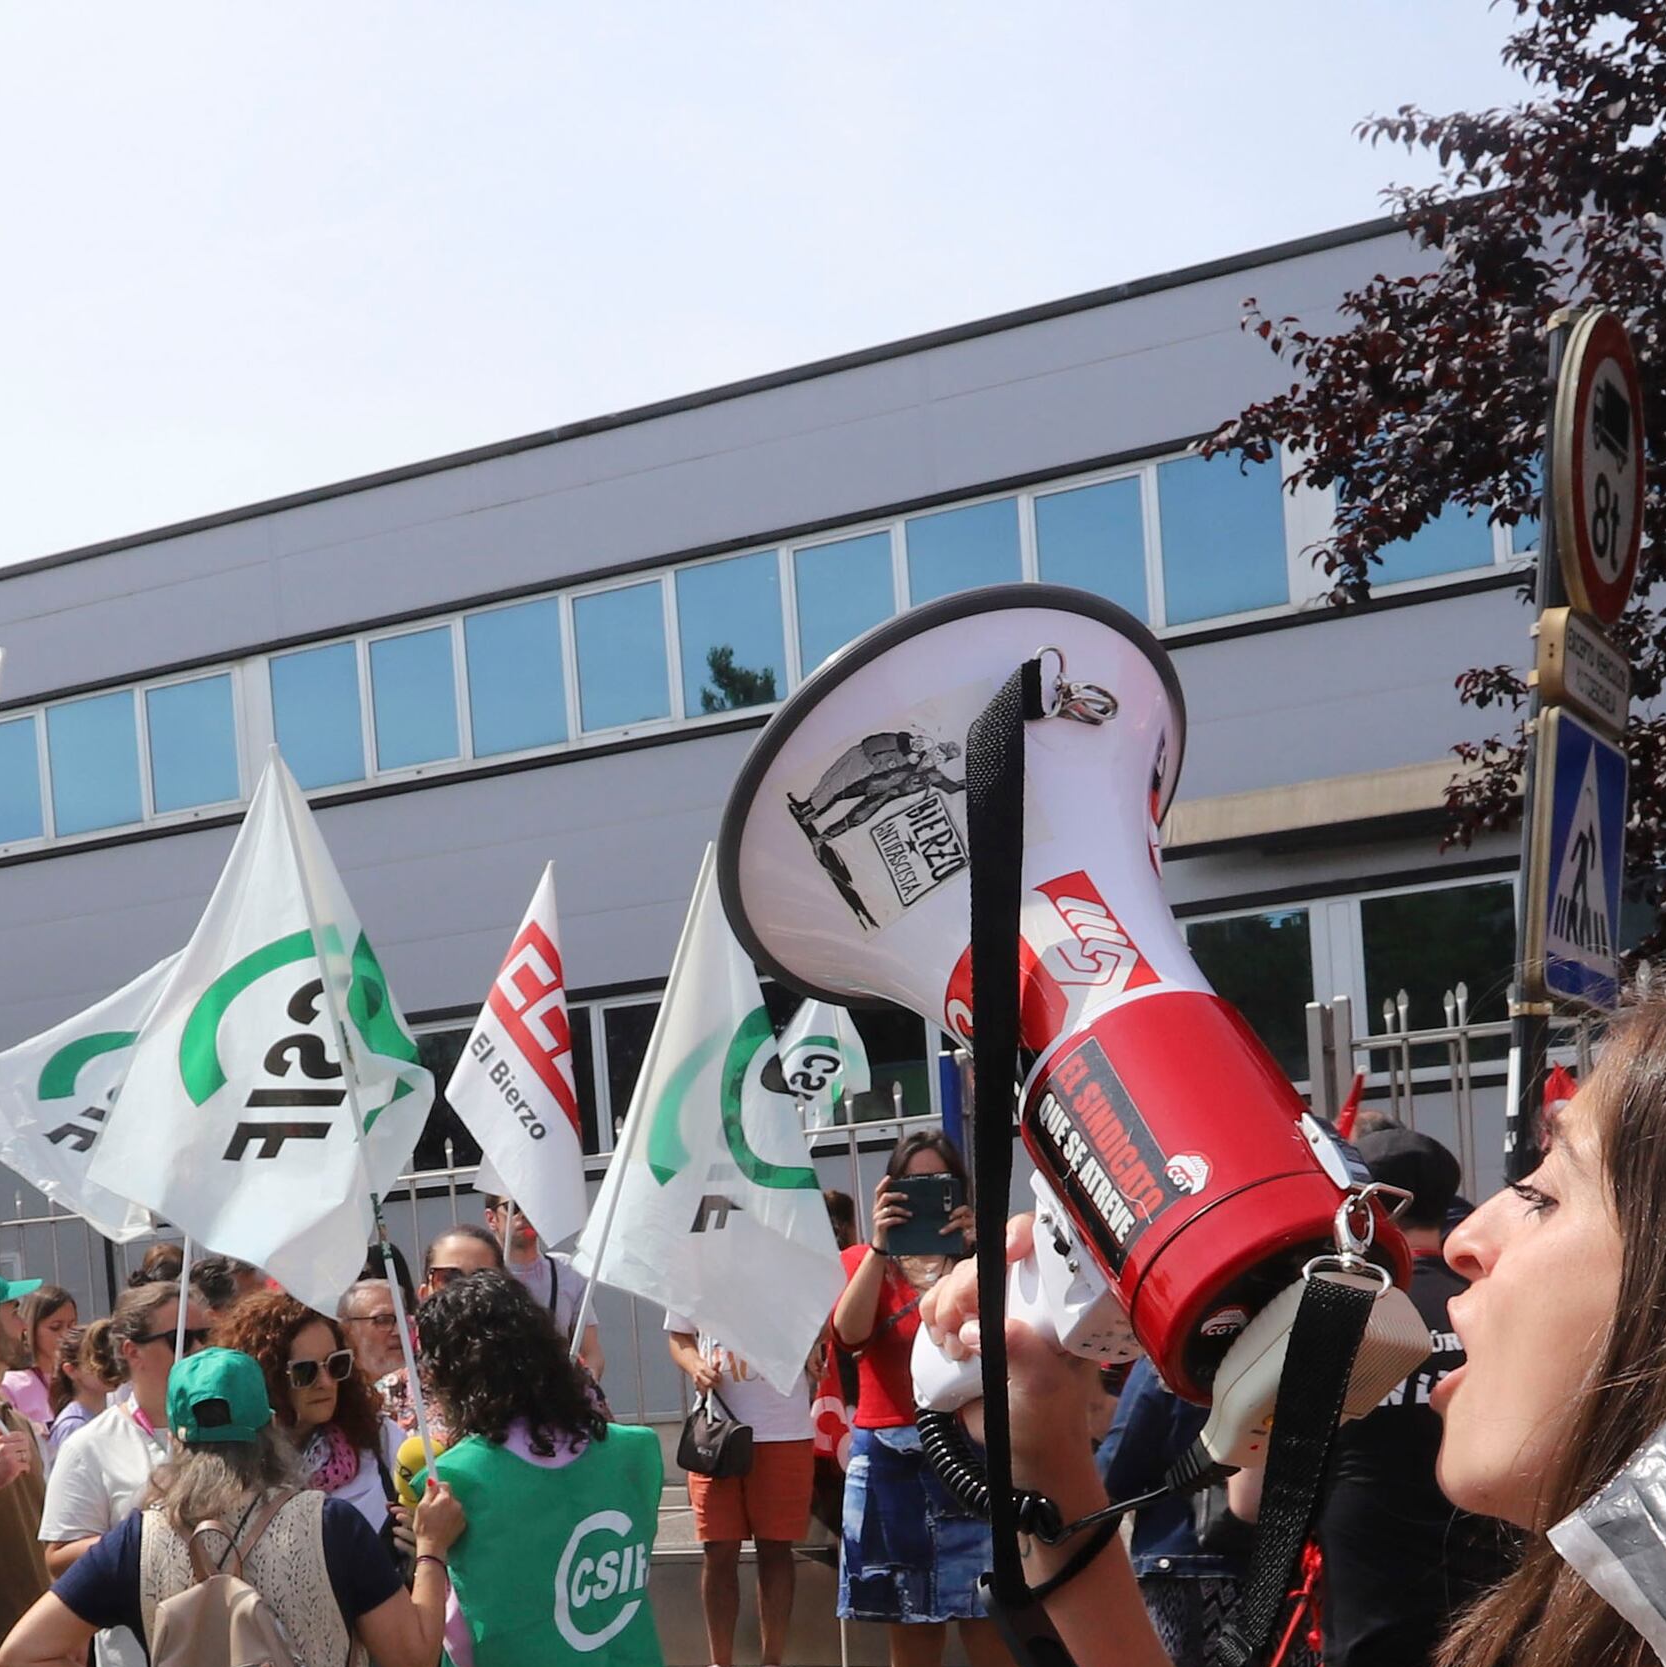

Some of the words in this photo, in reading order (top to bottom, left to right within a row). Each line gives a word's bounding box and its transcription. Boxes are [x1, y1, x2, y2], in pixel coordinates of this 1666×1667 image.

[1593, 471, 1621, 574] 8t
[470, 1032, 495, 1064] El
[489, 1060, 547, 1140] Bierzo
[1056, 1054, 1090, 1096] EL
[1039, 1092, 1073, 1147] QUE
[1062, 1129, 1090, 1173] SE
[1078, 1156, 1137, 1245] ATREVE
[1072, 1081, 1165, 1220] SINDICATO
[1166, 1165, 1194, 1194] CGT
[1206, 1324, 1238, 1337] CGT
[570, 1541, 651, 1609] CSIF
